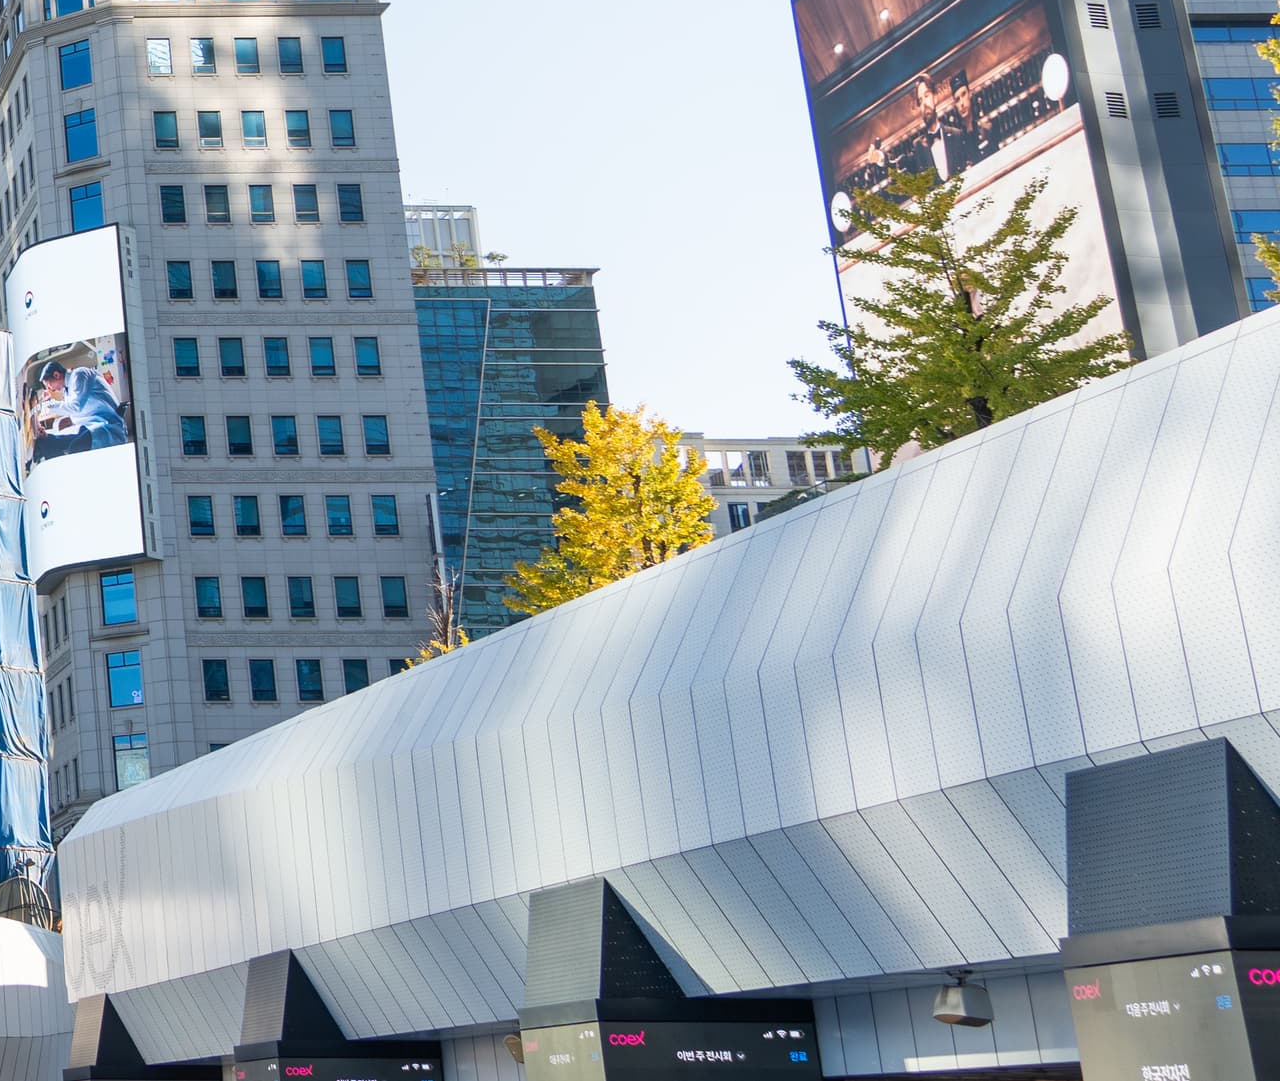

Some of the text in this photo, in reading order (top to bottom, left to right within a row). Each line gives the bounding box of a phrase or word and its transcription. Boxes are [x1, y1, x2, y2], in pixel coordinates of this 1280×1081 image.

[1072, 978, 1102, 1001] coex
[609, 1030, 646, 1046] coex
[285, 1064, 313, 1077] coex
